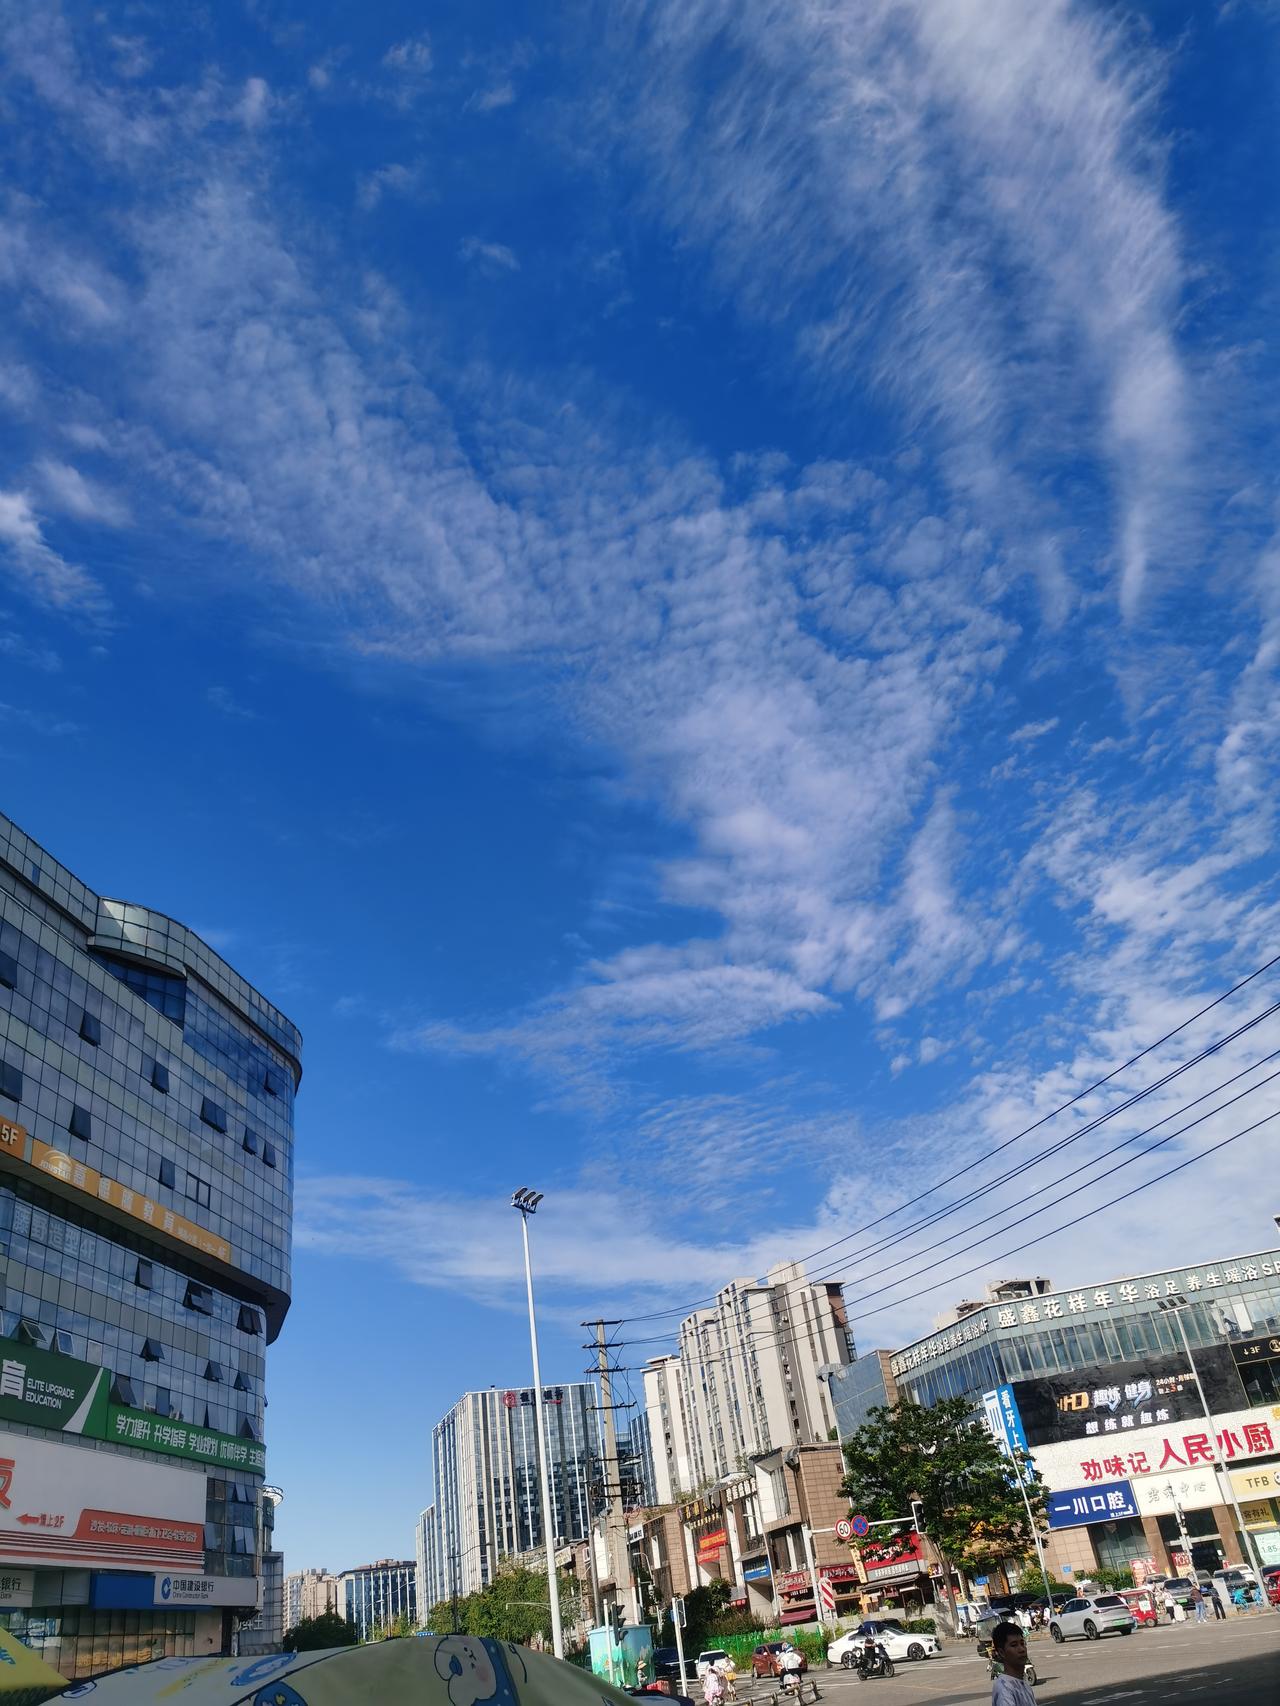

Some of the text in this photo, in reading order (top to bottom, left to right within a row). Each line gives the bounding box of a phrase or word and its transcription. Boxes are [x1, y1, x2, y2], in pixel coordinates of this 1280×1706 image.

[1, 1124, 19, 1145] 5F
[27, 1378, 75, 1399] ELITE UPGRADE
[25, 1391, 62, 1409] EDUCATION
[116, 1414, 150, 1440] 学力提升
[154, 1424, 187, 1448] 升学指导
[1080, 1452, 1151, 1481] 劝味记
[1159, 1422, 1274, 1469] 人民小厨
[1246, 1477, 1269, 1489] TFB
[1054, 1490, 1127, 1515] 一川口腔
[173, 1580, 214, 1593] 中国建设银行
